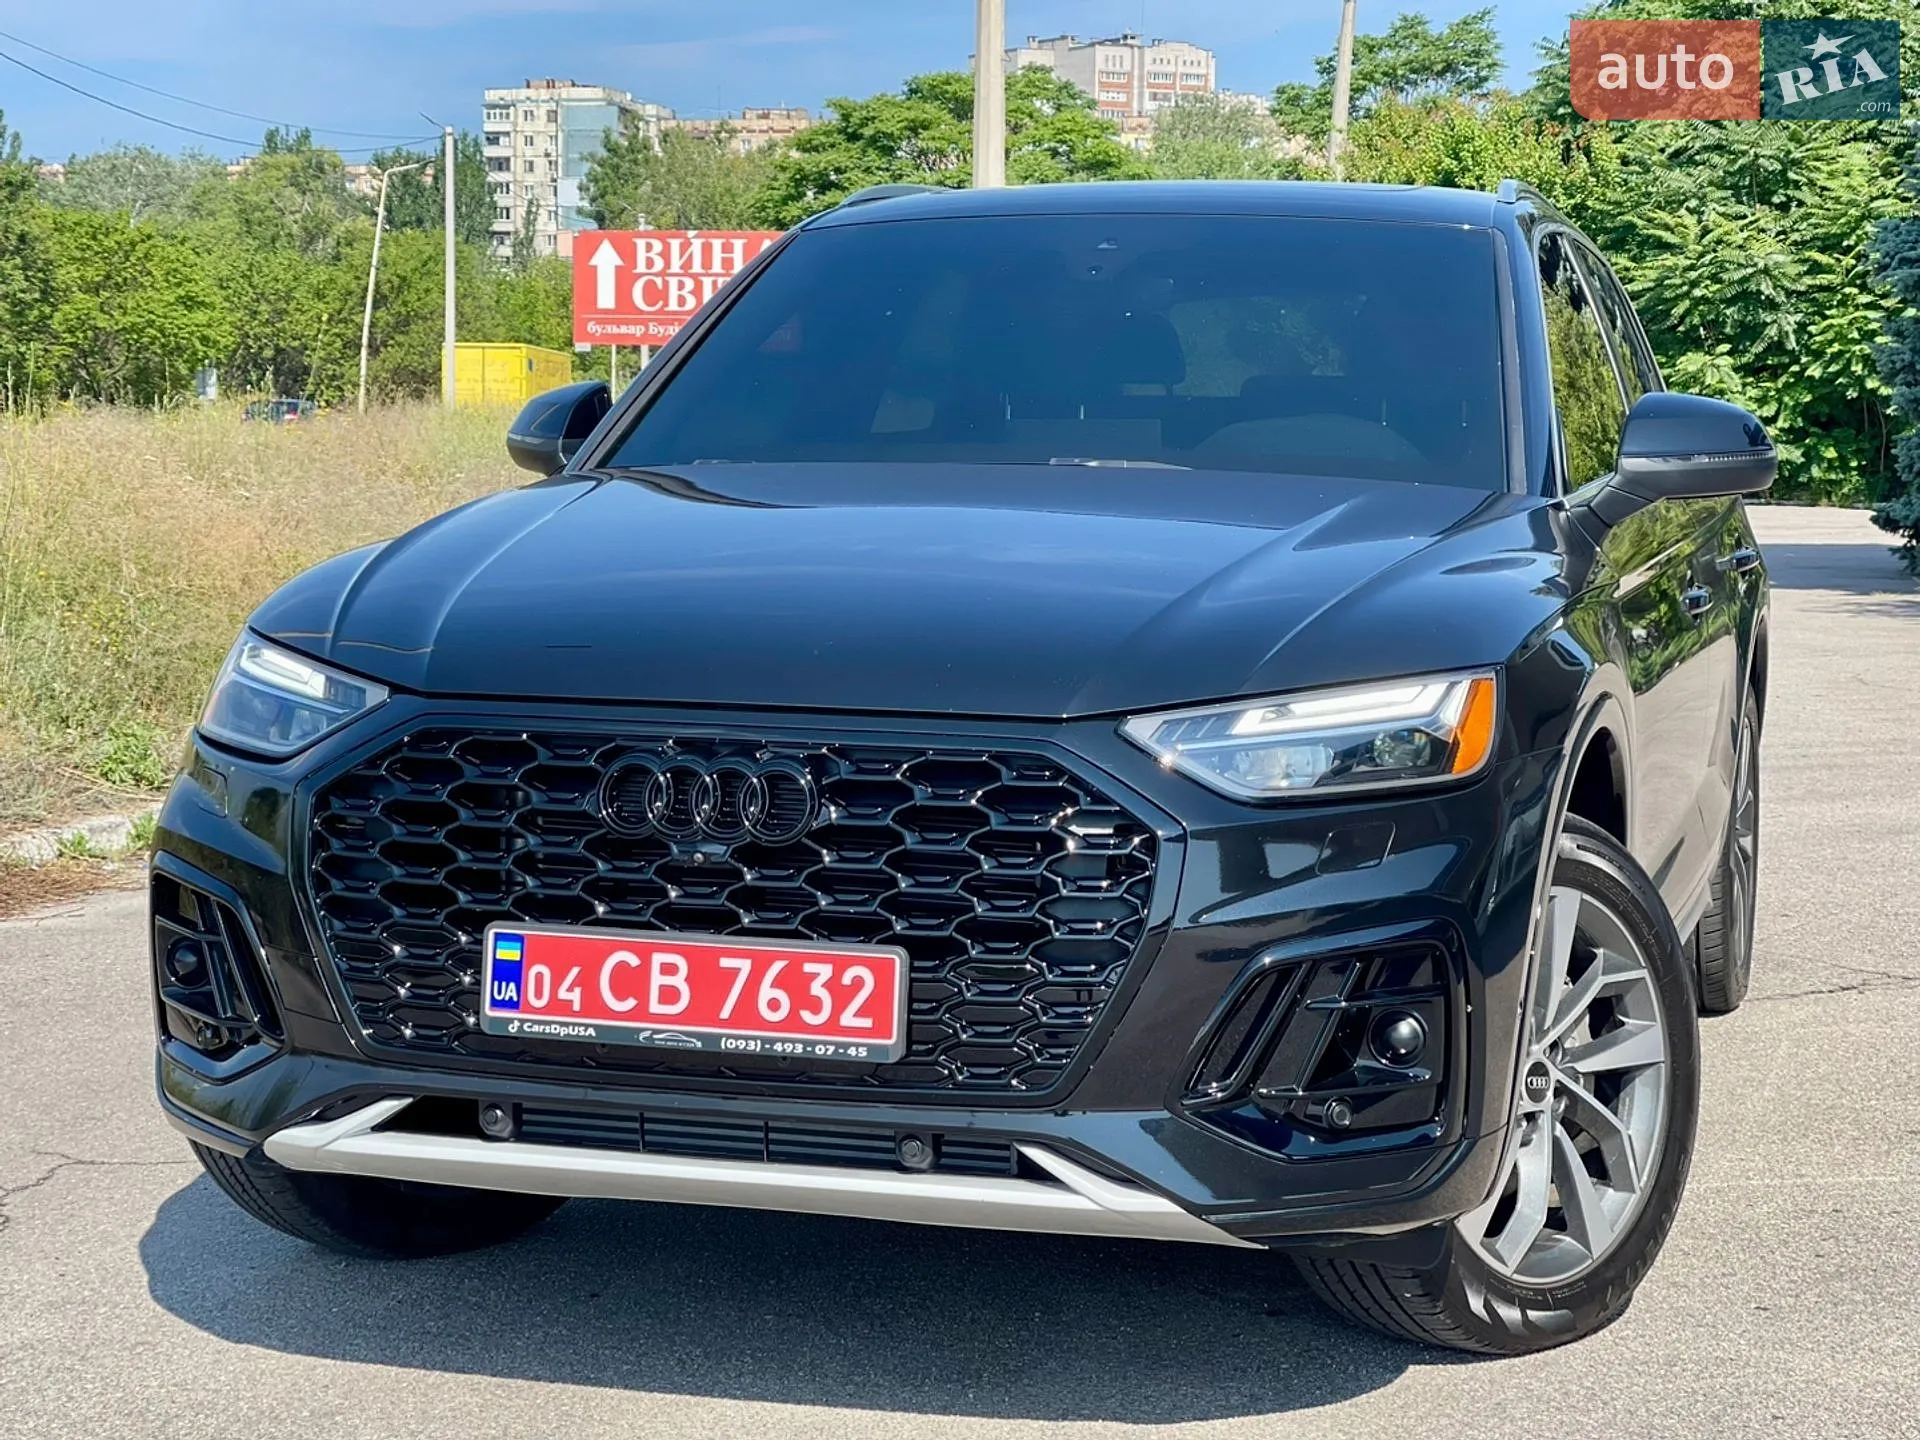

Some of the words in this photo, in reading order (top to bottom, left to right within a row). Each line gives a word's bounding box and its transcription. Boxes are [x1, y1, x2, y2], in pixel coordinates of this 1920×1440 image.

[631, 275, 731, 312] СВІ
[586, 321, 646, 337] бульвар
[493, 980, 518, 1002] UA
[526, 963, 583, 1013] 04
[599, 950, 691, 1015] CB
[718, 956, 876, 1029] 7632
[523, 1022, 597, 1037] CarsDpUSA
